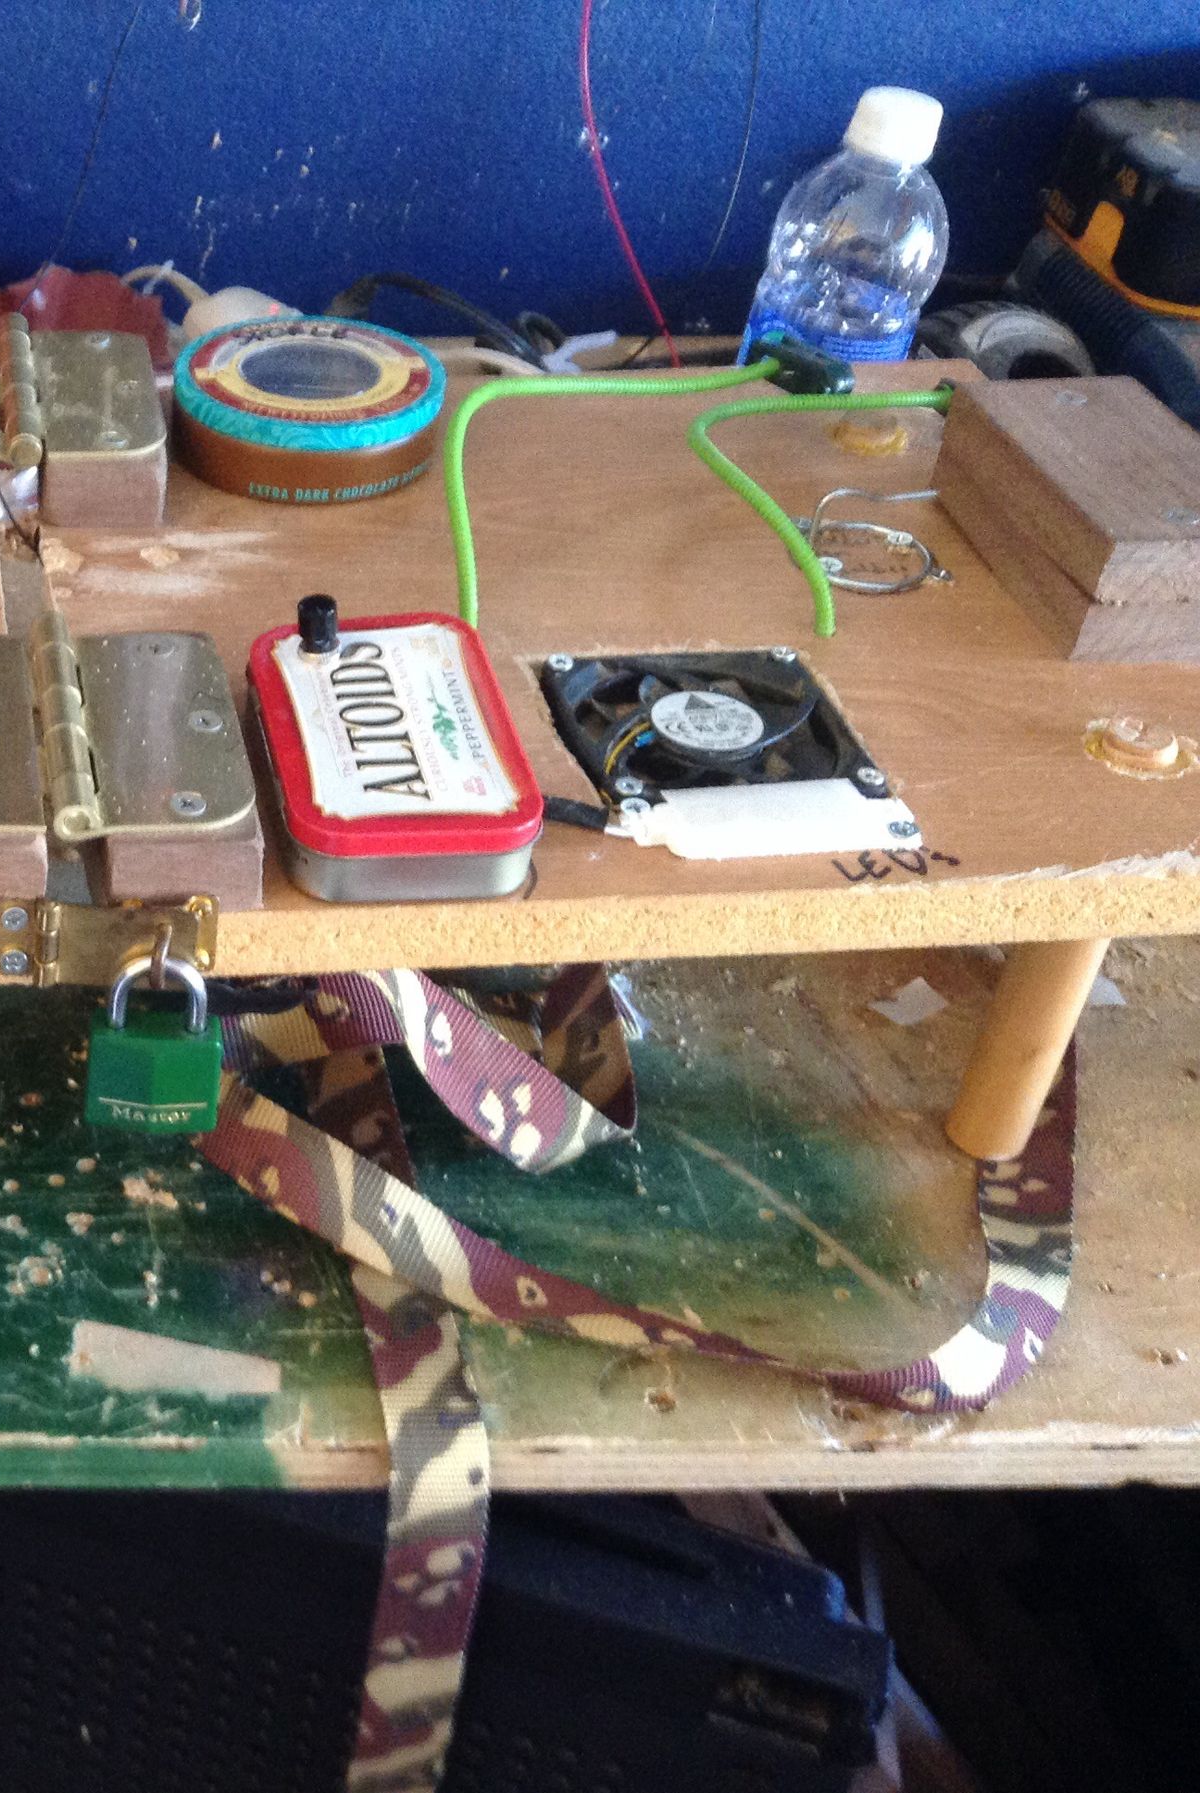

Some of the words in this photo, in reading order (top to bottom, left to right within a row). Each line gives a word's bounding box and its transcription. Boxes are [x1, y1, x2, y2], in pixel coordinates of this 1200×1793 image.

[248, 481, 289, 501] EXTRA
[295, 487, 330, 501] DARK
[333, 475, 401, 501] CHOCOLATE
[329, 641, 433, 800] ALTOIDS
[442, 671, 486, 760] PEPPERMINT
